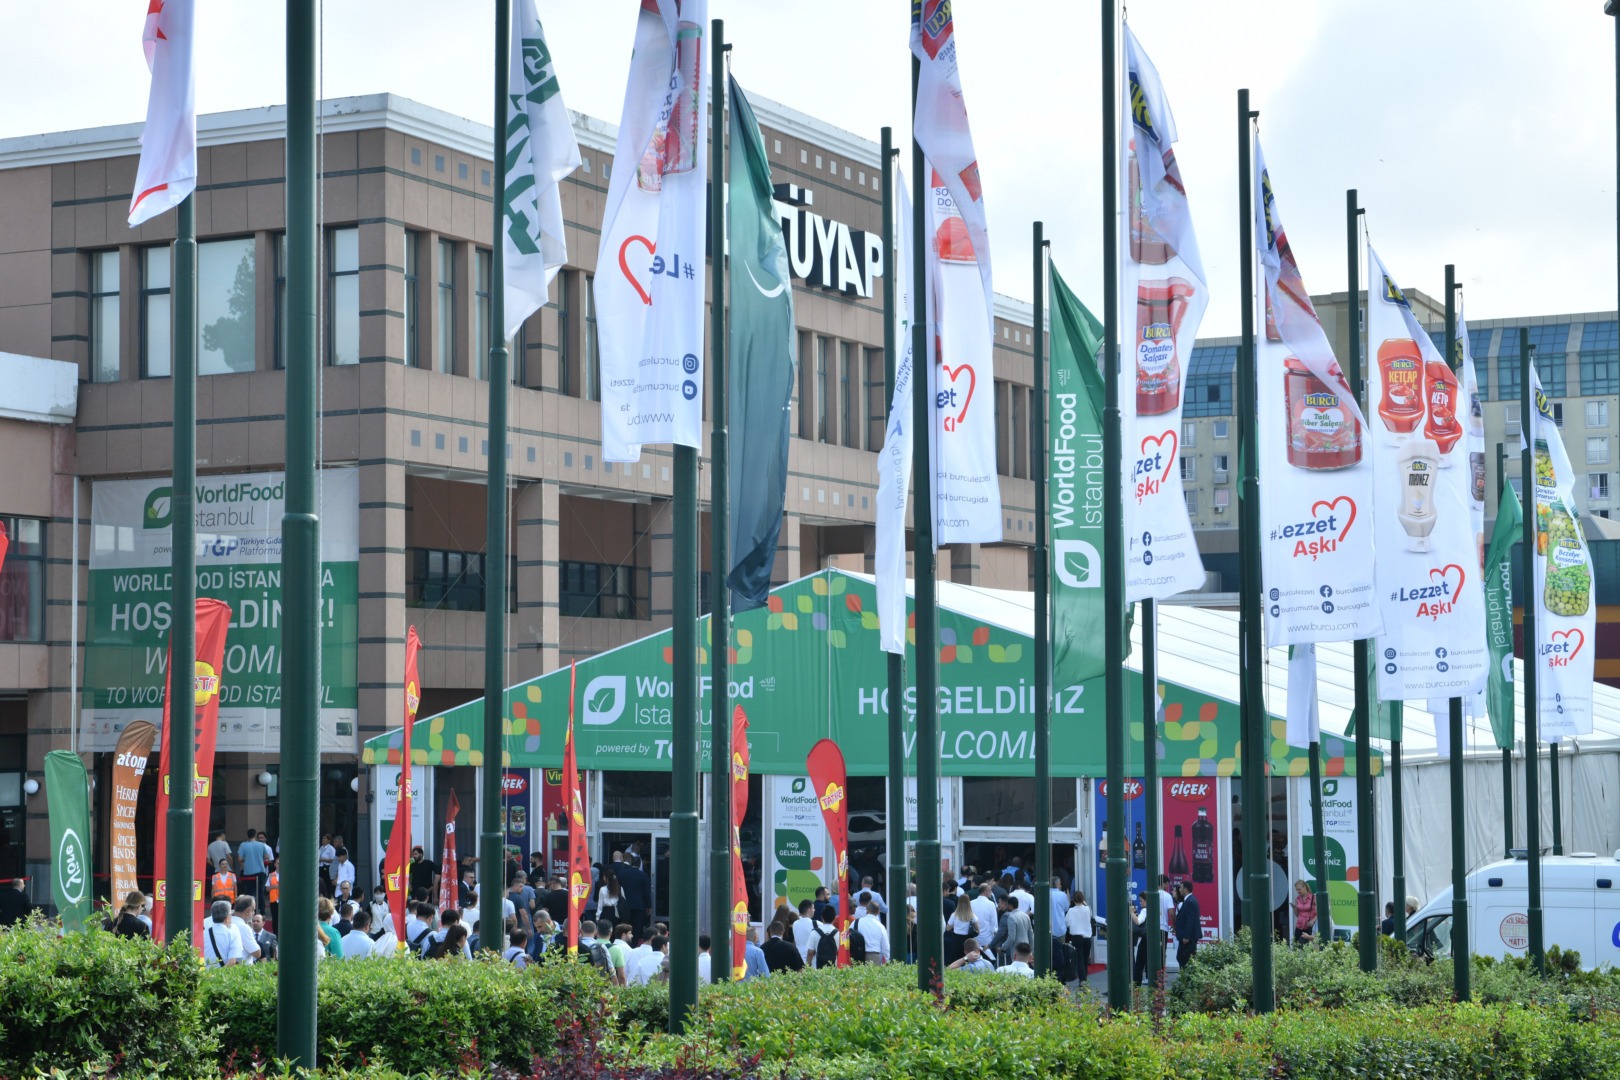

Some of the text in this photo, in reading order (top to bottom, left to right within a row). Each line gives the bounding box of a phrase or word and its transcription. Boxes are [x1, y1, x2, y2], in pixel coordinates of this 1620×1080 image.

[1389, 370, 1418, 385] KETÇAP
[1306, 396, 1338, 406] BURCU
[1052, 393, 1077, 529] WorldFood
[1080, 433, 1104, 529] Istanbul
[195, 506, 255, 527] stanbul
[201, 539, 238, 557] TGP
[1293, 536, 1337, 561] Aşkı
[1560, 540, 1580, 549] BURCU
[1390, 581, 1450, 602] #Lezzet
[1416, 600, 1452, 622] Aşkı
[111, 602, 172, 639] HOŞ
[1287, 621, 1358, 633] www.burcu.com
[1405, 680, 1470, 690] www.burcu.com
[107, 687, 127, 704] TO
[596, 744, 637, 755] powered
[638, 743, 650, 756] by
[116, 751, 148, 769] atom
[1171, 781, 1208, 797] ÇİÇEK
[781, 796, 817, 804] WorldFood
[785, 804, 812, 812] Istanbul
[779, 848, 807, 857] GELDİNİZ
[786, 841, 799, 850] HOŞ
